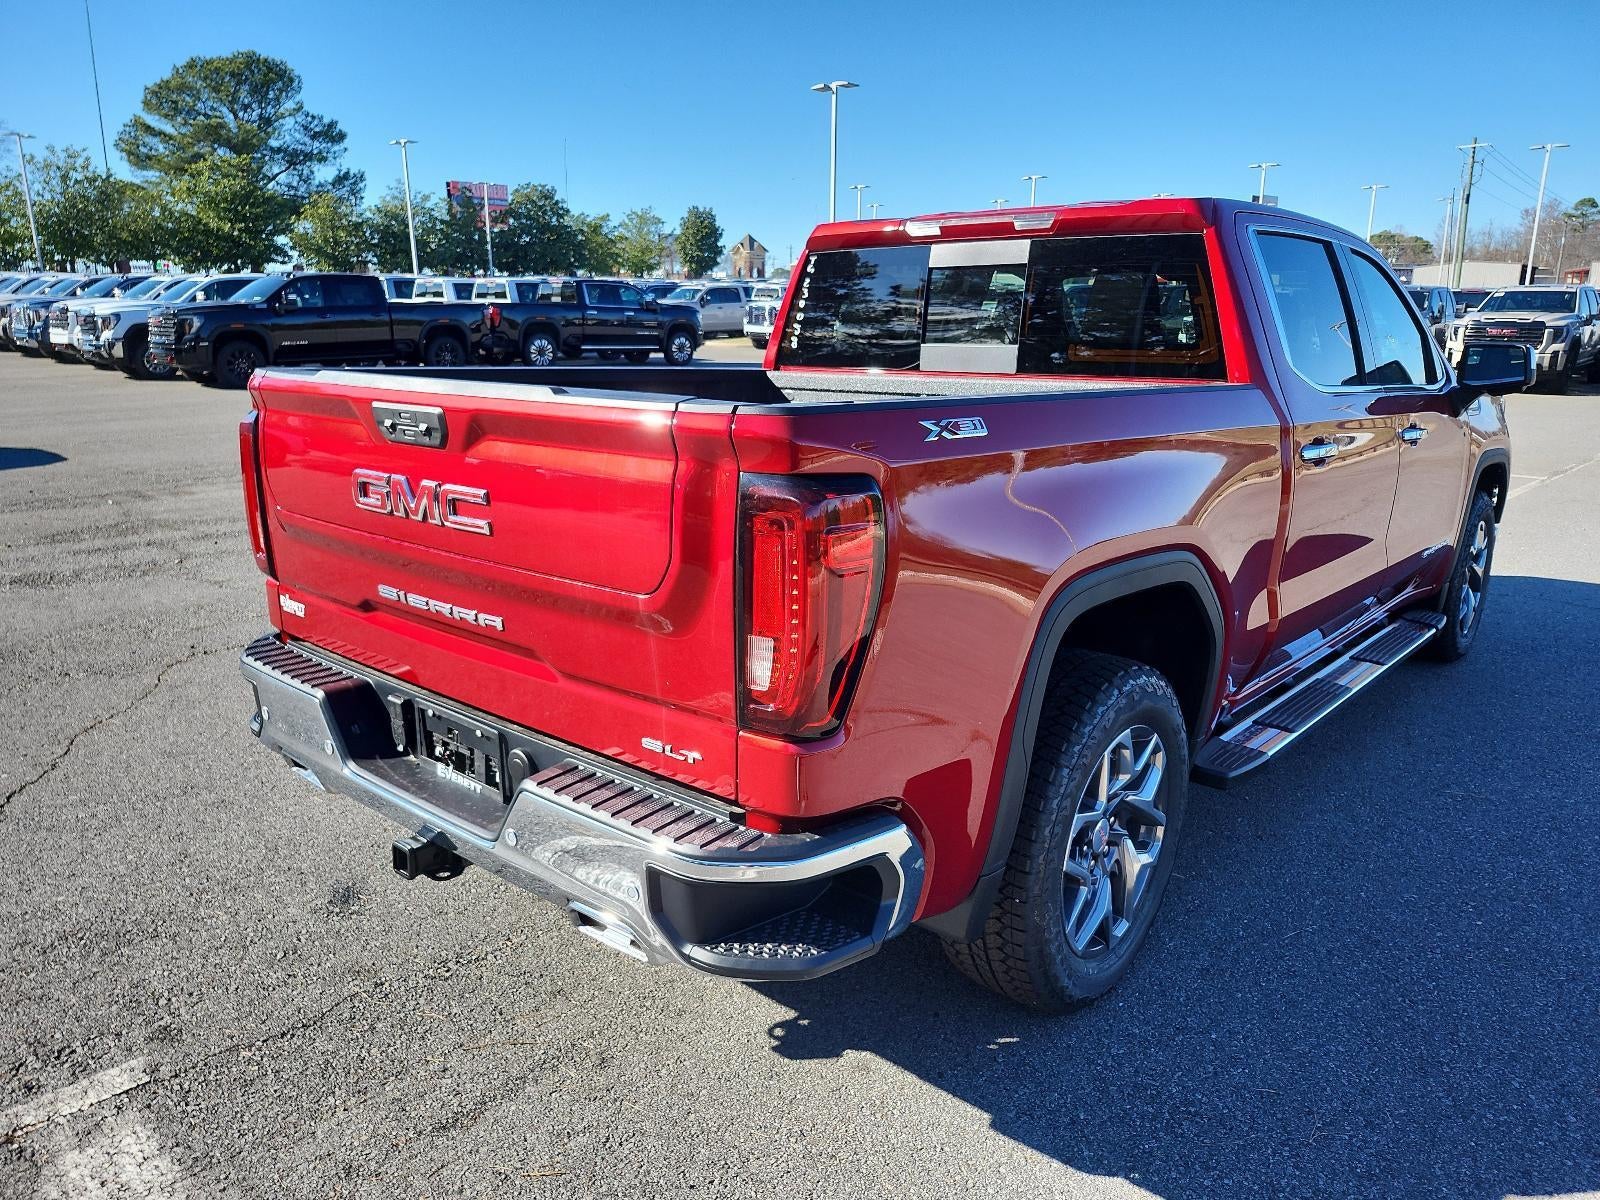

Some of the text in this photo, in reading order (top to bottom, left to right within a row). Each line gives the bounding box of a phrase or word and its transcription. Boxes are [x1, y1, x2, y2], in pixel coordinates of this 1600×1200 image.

[918, 417, 989, 442] X31
[352, 468, 492, 536] GMC
[378, 584, 504, 631] SIERRA
[641, 737, 703, 764] SLT
